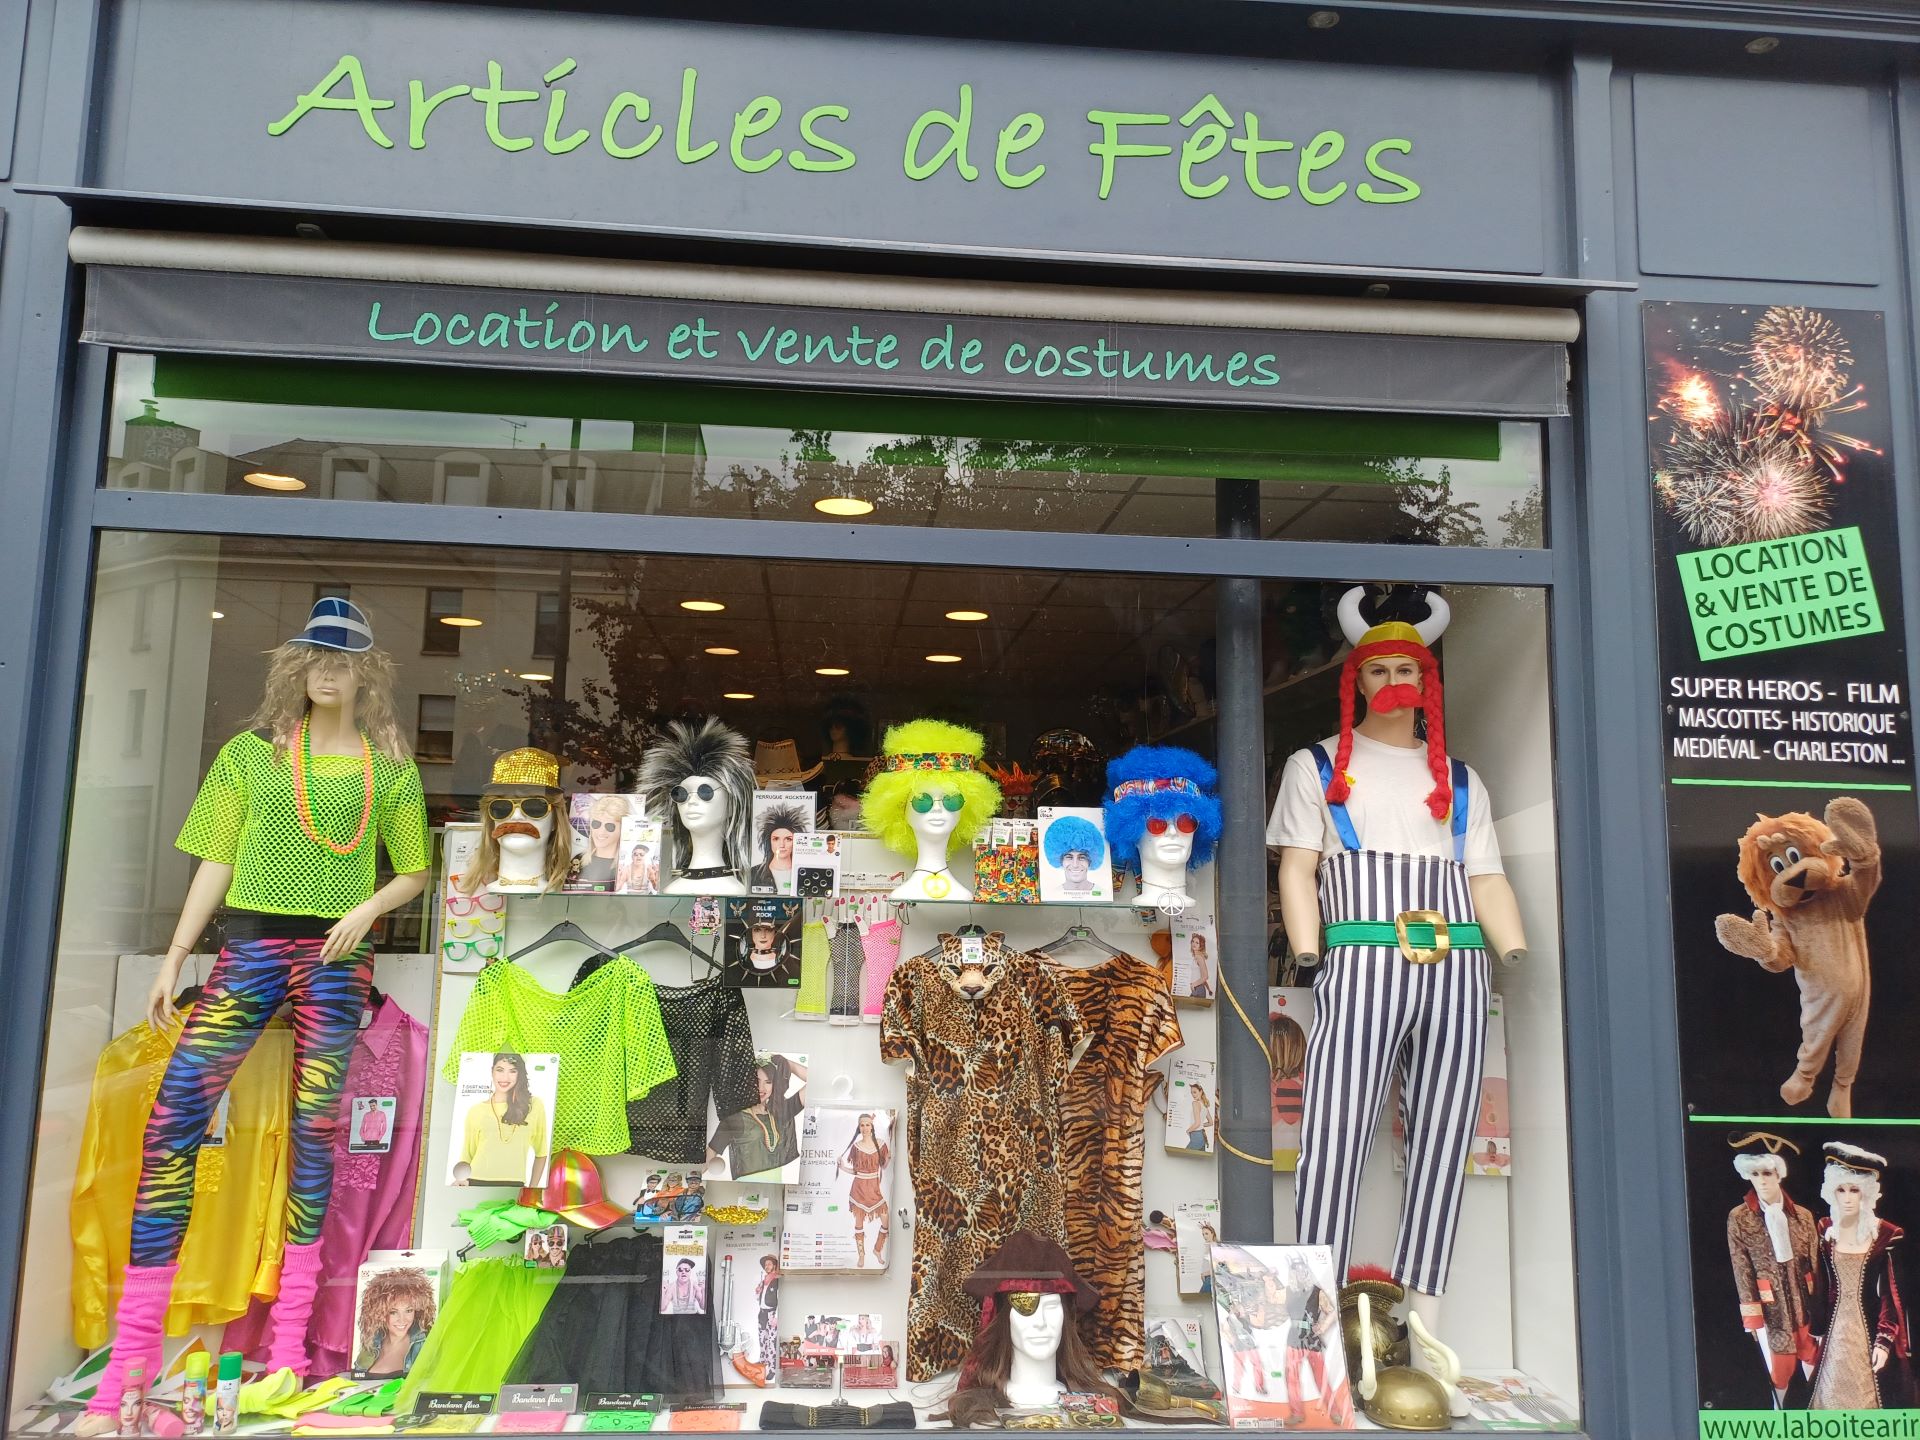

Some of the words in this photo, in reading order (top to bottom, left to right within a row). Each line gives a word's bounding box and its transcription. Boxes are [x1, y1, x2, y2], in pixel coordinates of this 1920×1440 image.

[267, 54, 857, 174] Articles
[903, 83, 1047, 189] de
[1086, 93, 1422, 206] Fêtes
[367, 301, 649, 354] Location
[666, 317, 721, 361] et
[737, 325, 900, 370] vente
[920, 323, 984, 375] de
[1004, 338, 1281, 387] costumes
[1694, 534, 1848, 582] LOCATION
[1695, 592, 1718, 618] &
[1719, 574, 1820, 613] VENTE
[1824, 566, 1868, 597] DE
[1705, 602, 1872, 652] COSTUMES
[1670, 676, 1743, 699] SUPER
[1747, 679, 1824, 702] HEROS
[1847, 682, 1901, 705] FILM
[1792, 710, 1897, 736] HISTORIQUE
[1673, 734, 1761, 760] MEDIÉVAL
[1773, 739, 1889, 764] CHARLESTON
[752, 904, 777, 912] COLLIER
[428, 1398, 463, 1409] Bandana
[511, 1392, 546, 1404] Bandana
[598, 1397, 632, 1406] Bandana
